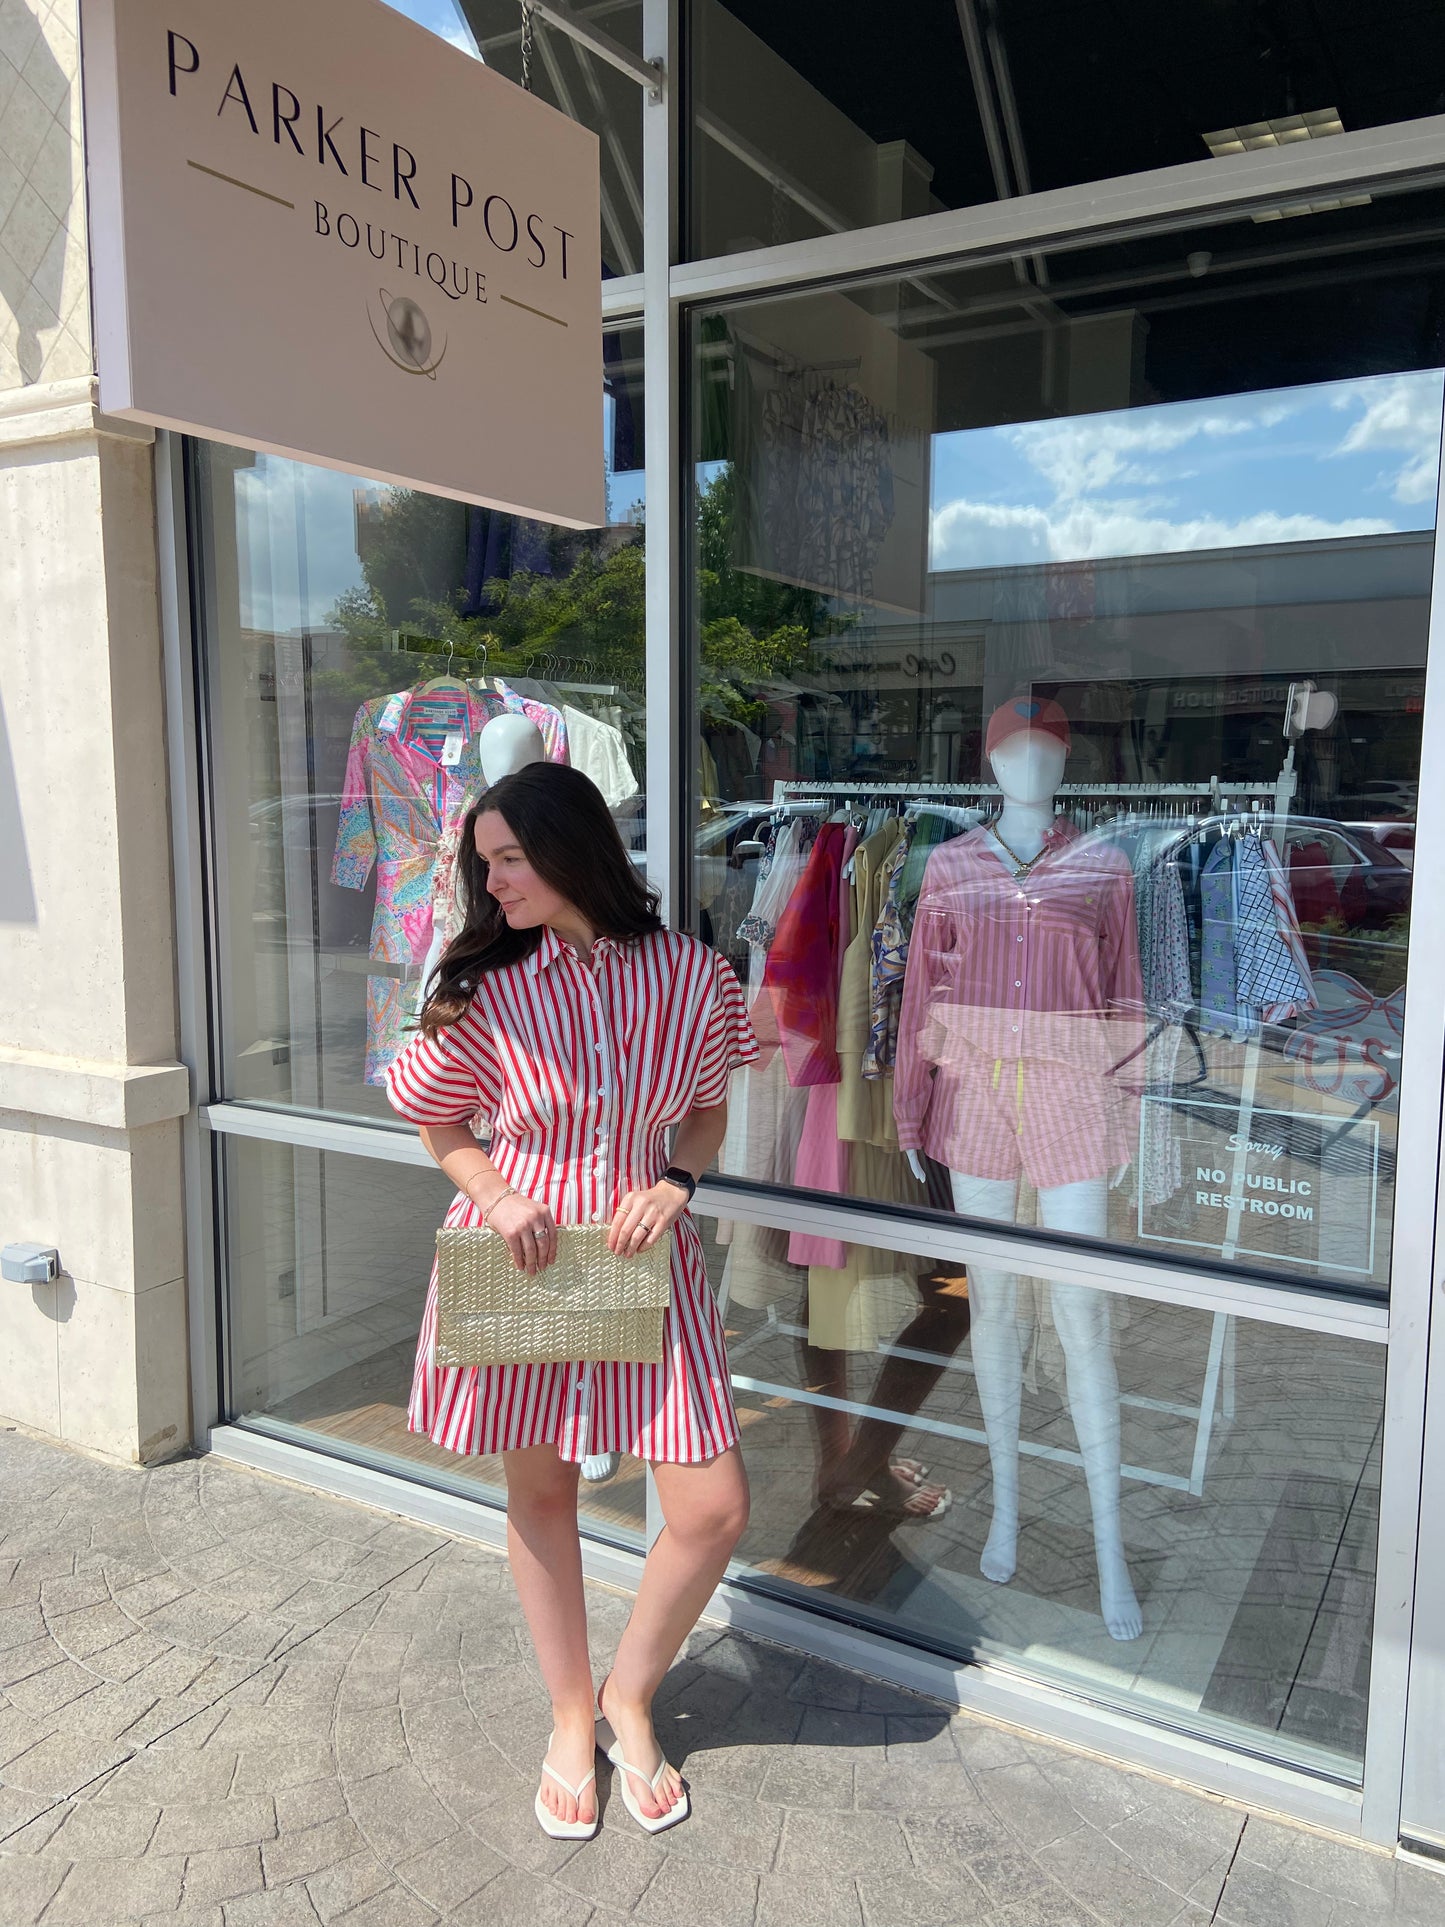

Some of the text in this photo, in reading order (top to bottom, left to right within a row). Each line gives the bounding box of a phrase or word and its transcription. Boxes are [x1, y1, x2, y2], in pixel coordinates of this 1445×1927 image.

[167, 29, 575, 280] PARKER POST
[313, 200, 488, 304] BOUTIQUE
[1225, 1133, 1286, 1161] Sorry
[1196, 1166, 1312, 1196] NO PUBLIC
[1196, 1190, 1314, 1221] RESTROOM
